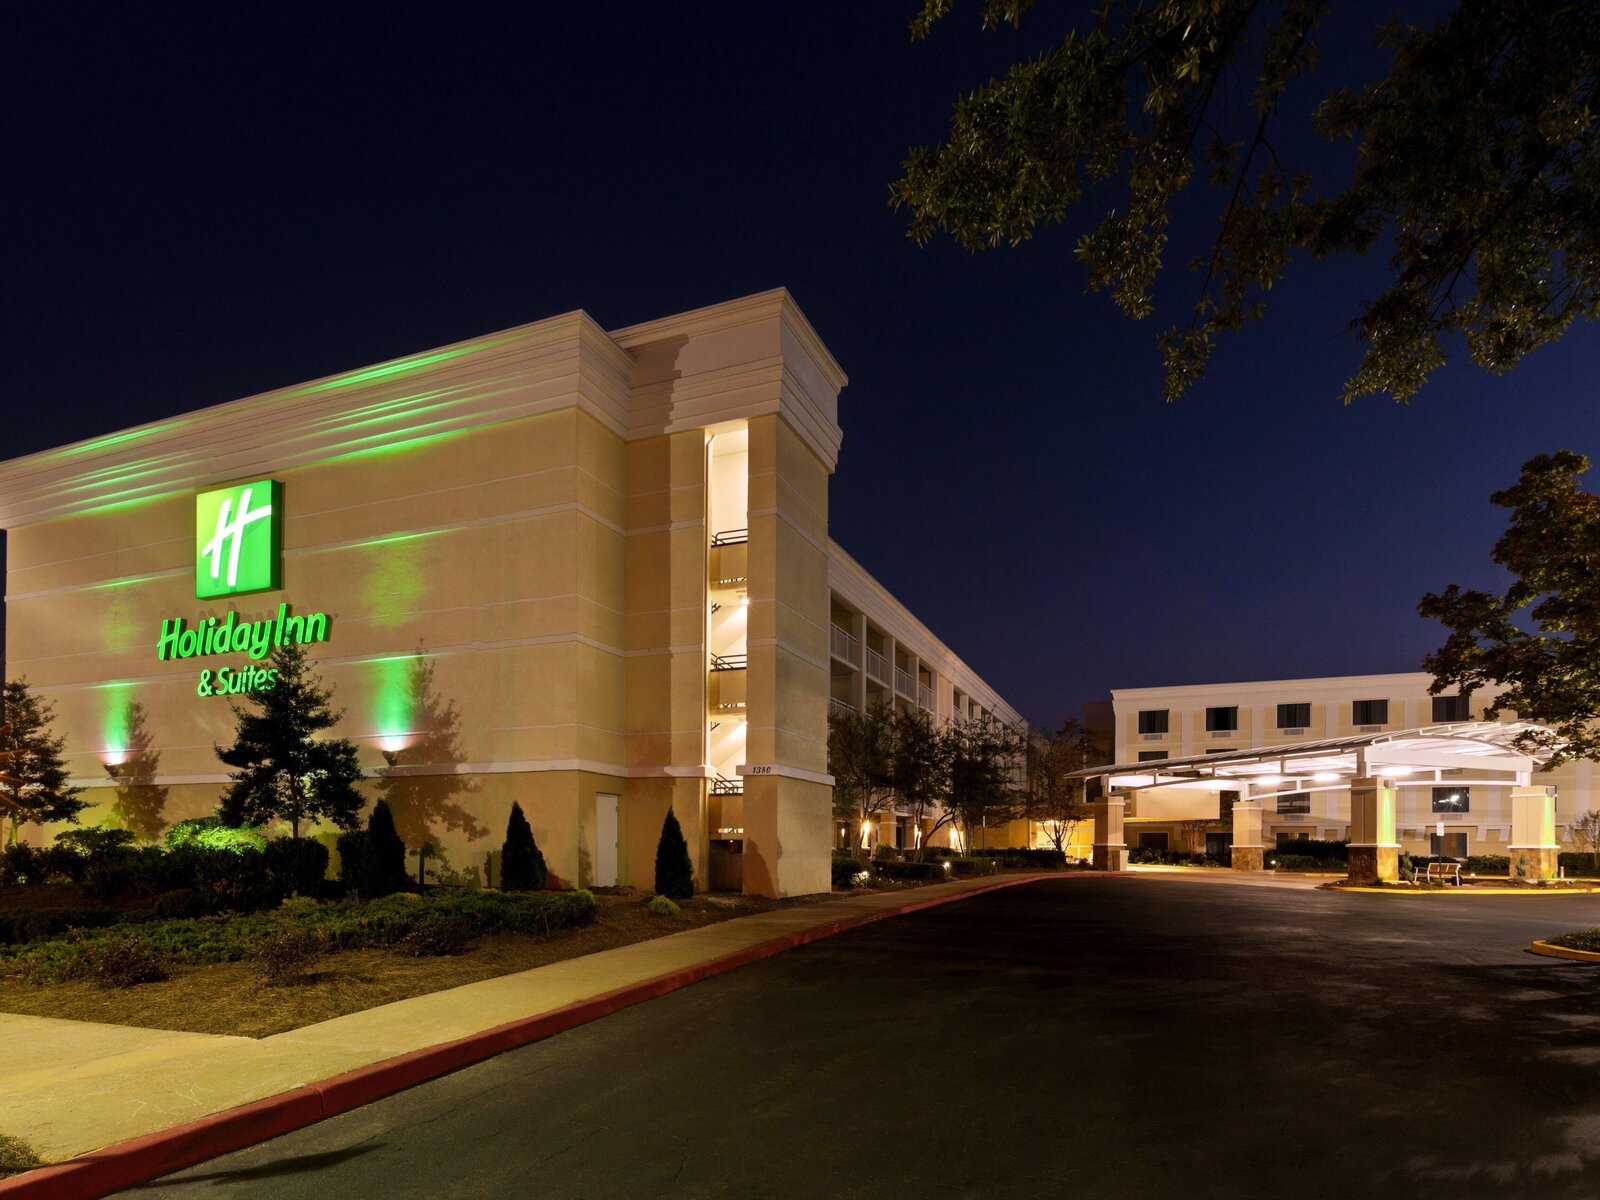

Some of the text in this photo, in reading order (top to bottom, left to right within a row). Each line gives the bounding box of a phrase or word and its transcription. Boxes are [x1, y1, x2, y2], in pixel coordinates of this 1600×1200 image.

[202, 488, 272, 587] H
[157, 603, 328, 660] Holiday Inn
[197, 665, 279, 697] & Suites
[752, 766, 772, 774] 1380
